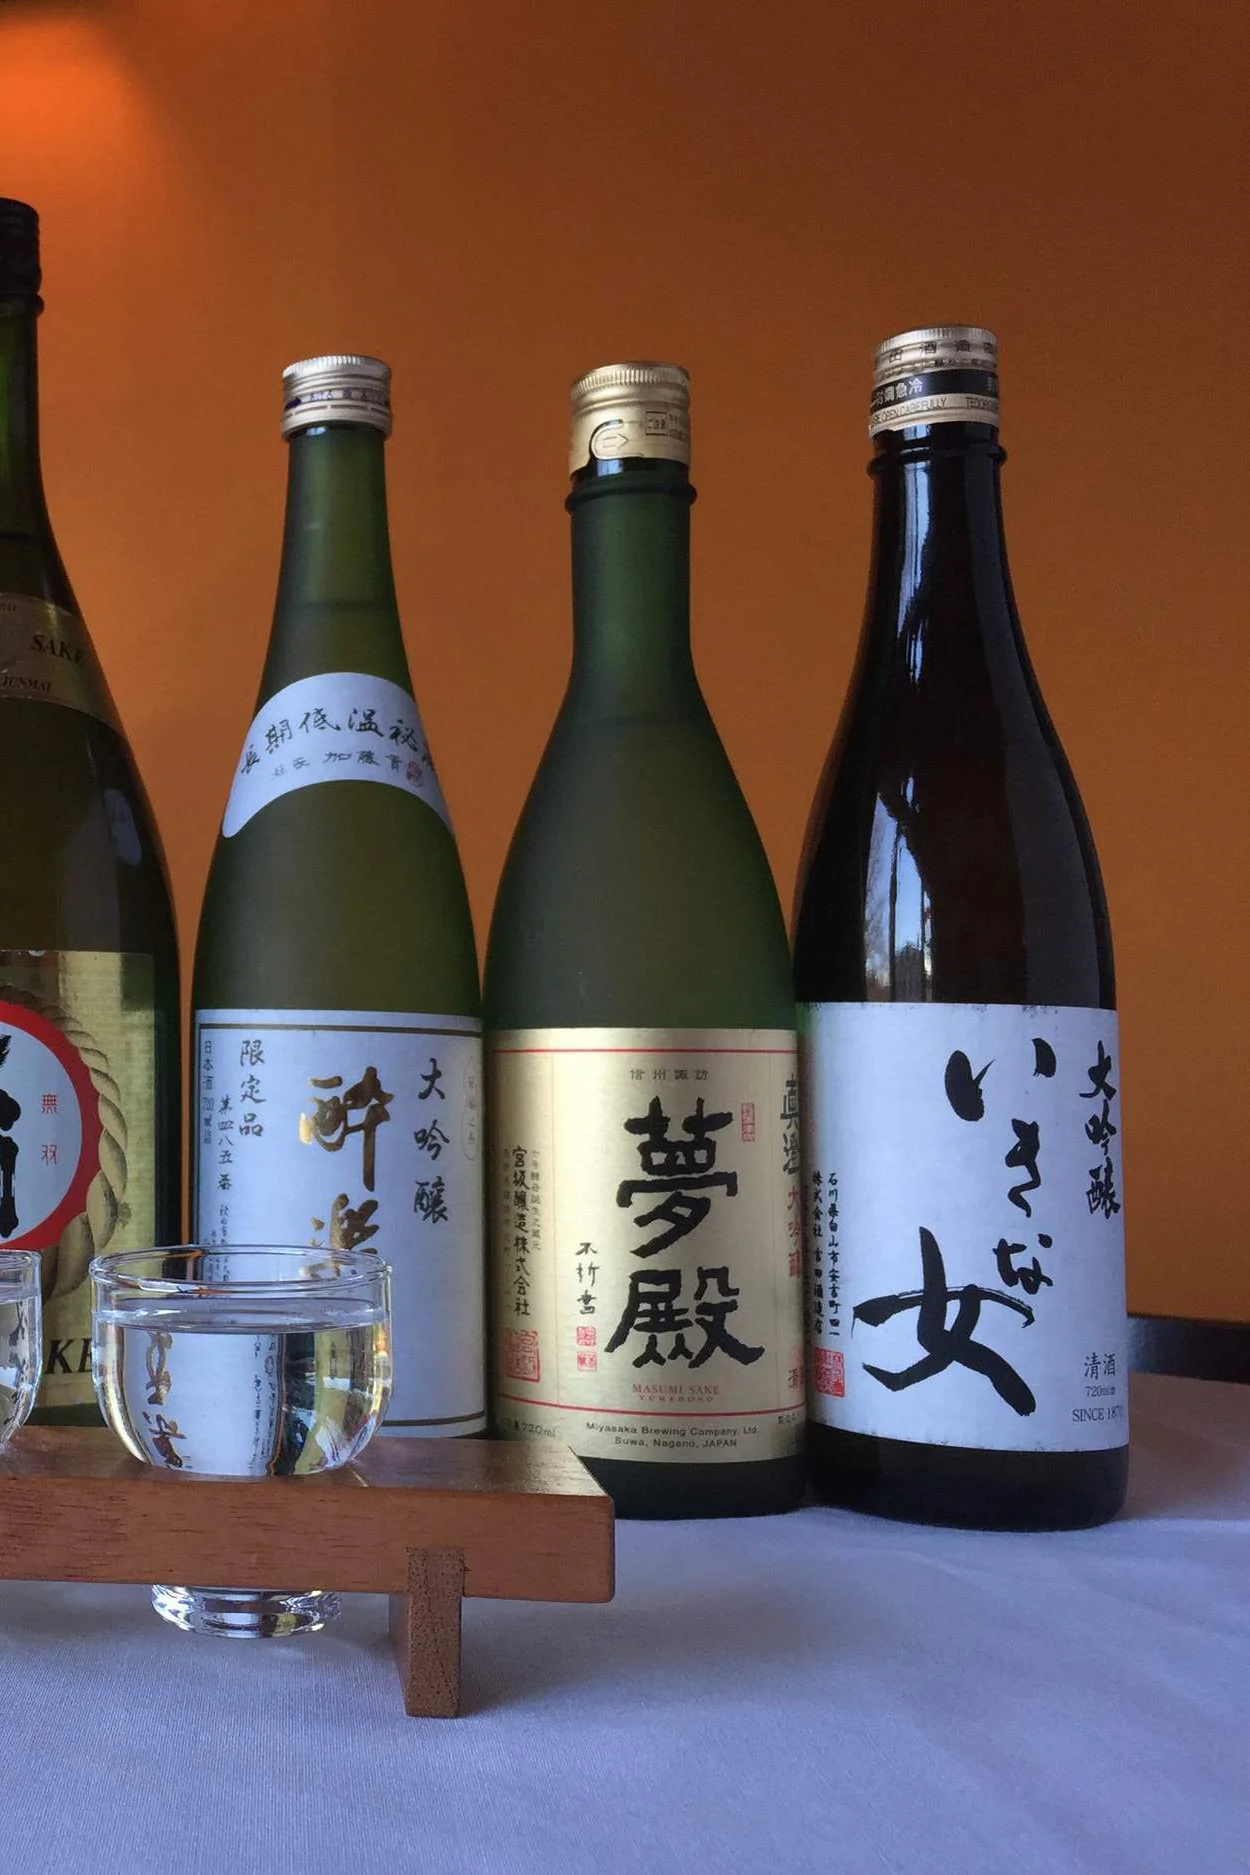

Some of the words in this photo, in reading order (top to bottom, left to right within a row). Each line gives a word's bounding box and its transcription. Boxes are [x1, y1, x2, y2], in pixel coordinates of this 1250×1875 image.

[31, 633, 87, 665] SAKE
[238, 1038, 267, 1138] 限定品
[413, 1057, 451, 1225] 大吟醸
[603, 1095, 766, 1370] 夢殿
[1083, 1352, 1116, 1380] 清酒
[632, 1383, 684, 1395] MASUMI
[688, 1384, 721, 1395] SAKE
[1072, 1407, 1105, 1423] SINCE
[586, 1421, 638, 1435] Miyasaka
[641, 1425, 686, 1438] Brewing
[614, 1436, 649, 1448] Suwa,
[652, 1438, 700, 1450] Nagano,
[702, 1438, 738, 1448] JAPAN
